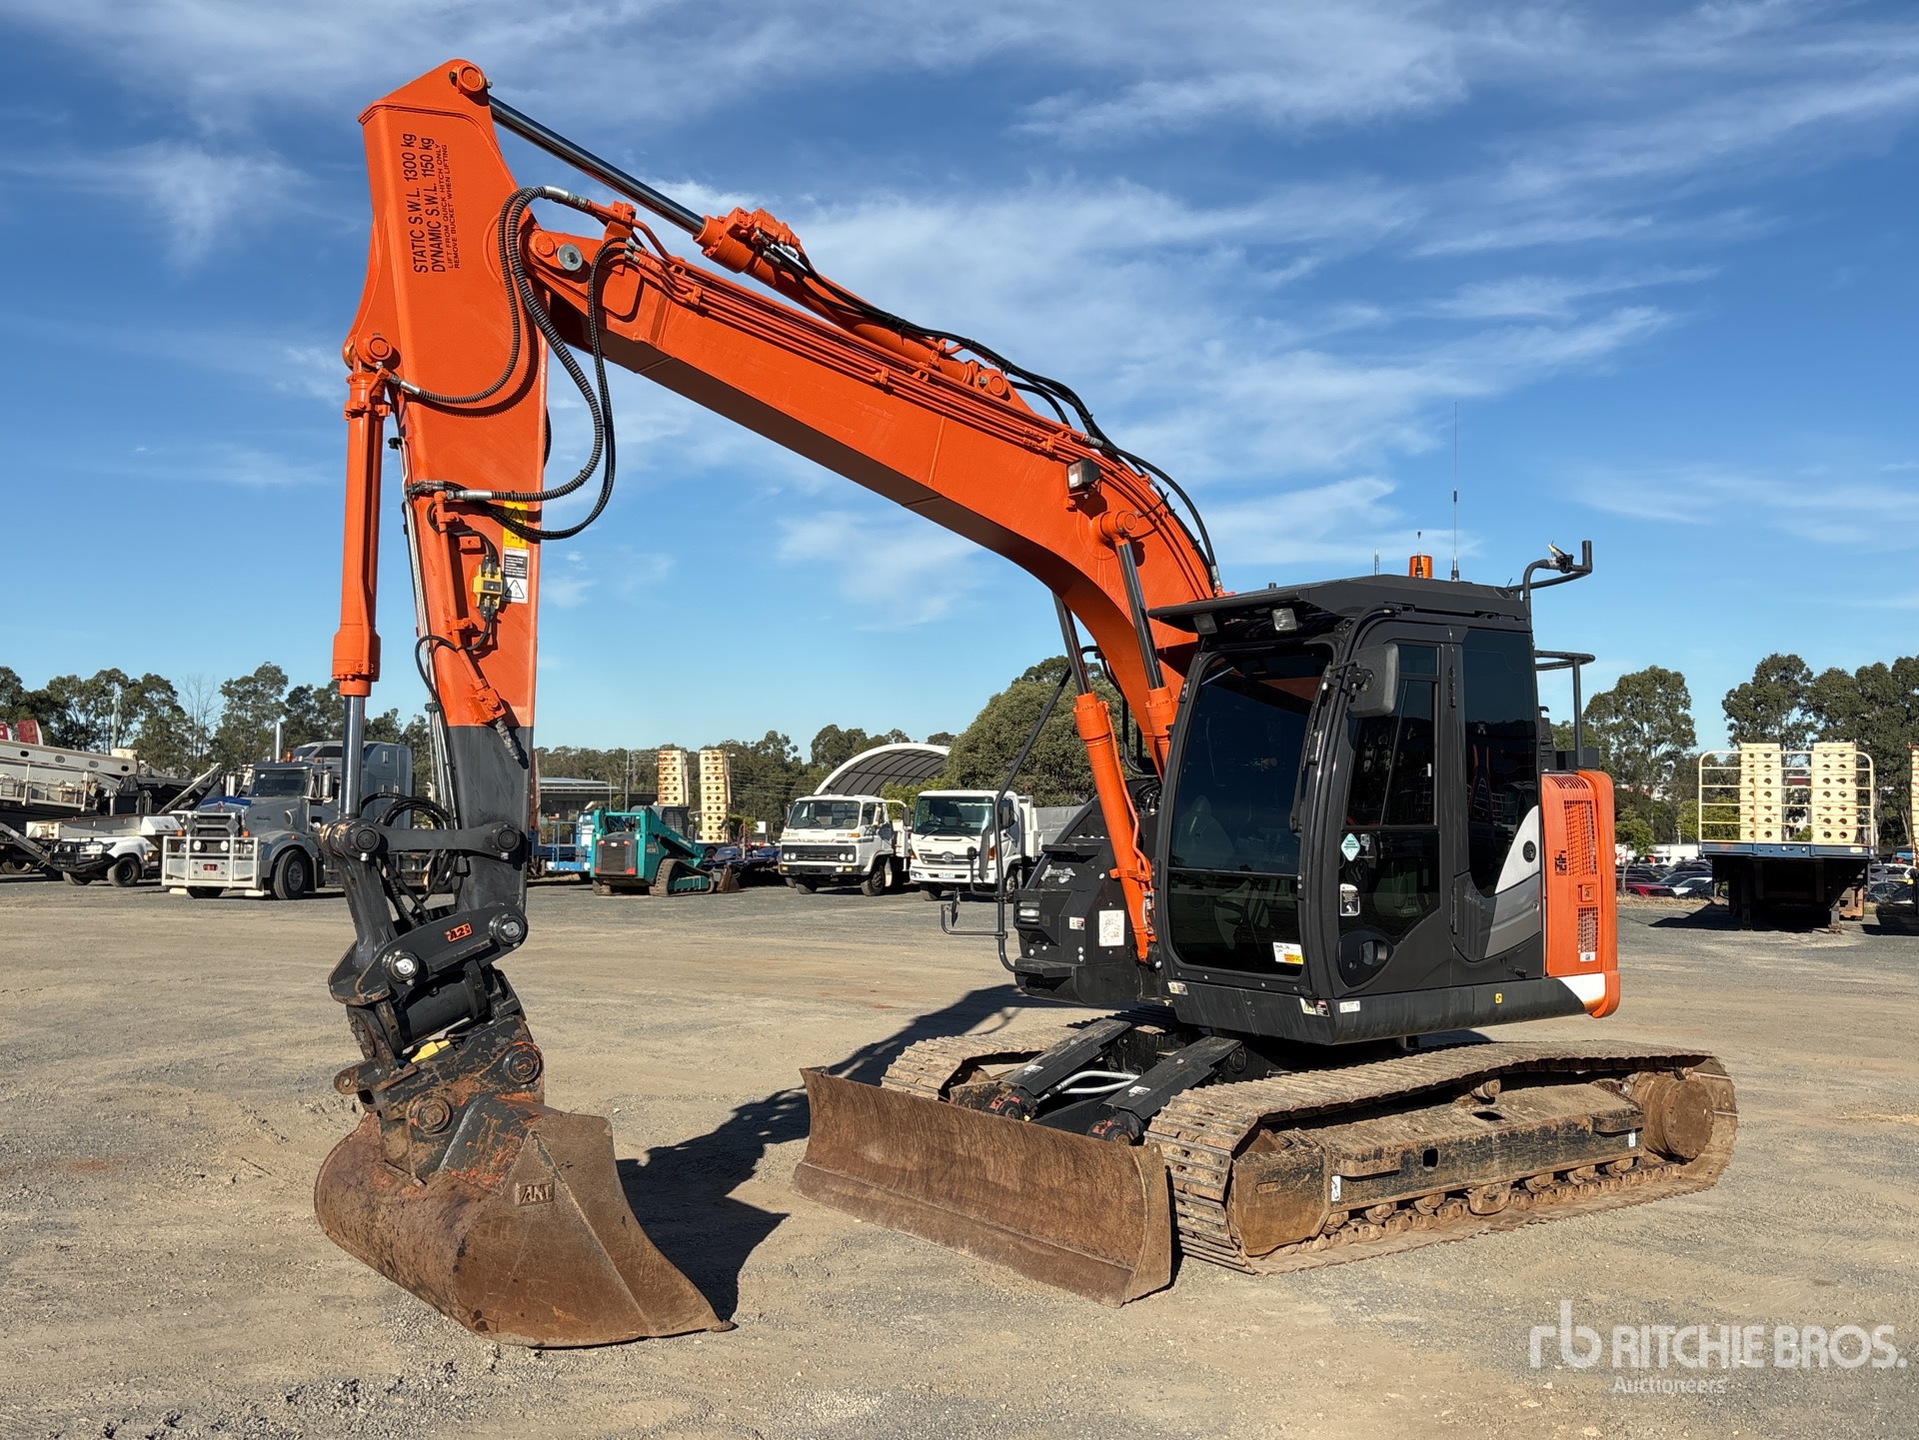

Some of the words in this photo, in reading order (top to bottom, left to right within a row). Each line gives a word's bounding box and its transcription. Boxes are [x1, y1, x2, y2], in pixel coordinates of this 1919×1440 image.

[401, 134, 417, 147] kg
[419, 138, 435, 150] kg
[402, 152, 418, 182] 1300
[420, 154, 435, 178] 1150
[435, 144, 443, 165] ONLY
[442, 145, 450, 174] LIFTING
[438, 168, 446, 193] HITCH
[445, 177, 453, 199] WHEN
[406, 188, 423, 225] S.W.L.
[423, 183, 440, 216] S.W.L.
[441, 196, 449, 221] QUICK
[448, 203, 456, 234] BUCKET
[427, 221, 446, 272] DYNAMIC
[444, 225, 452, 248] FROM
[410, 230, 428, 273] STATIC
[452, 237, 460, 269] REMOVE
